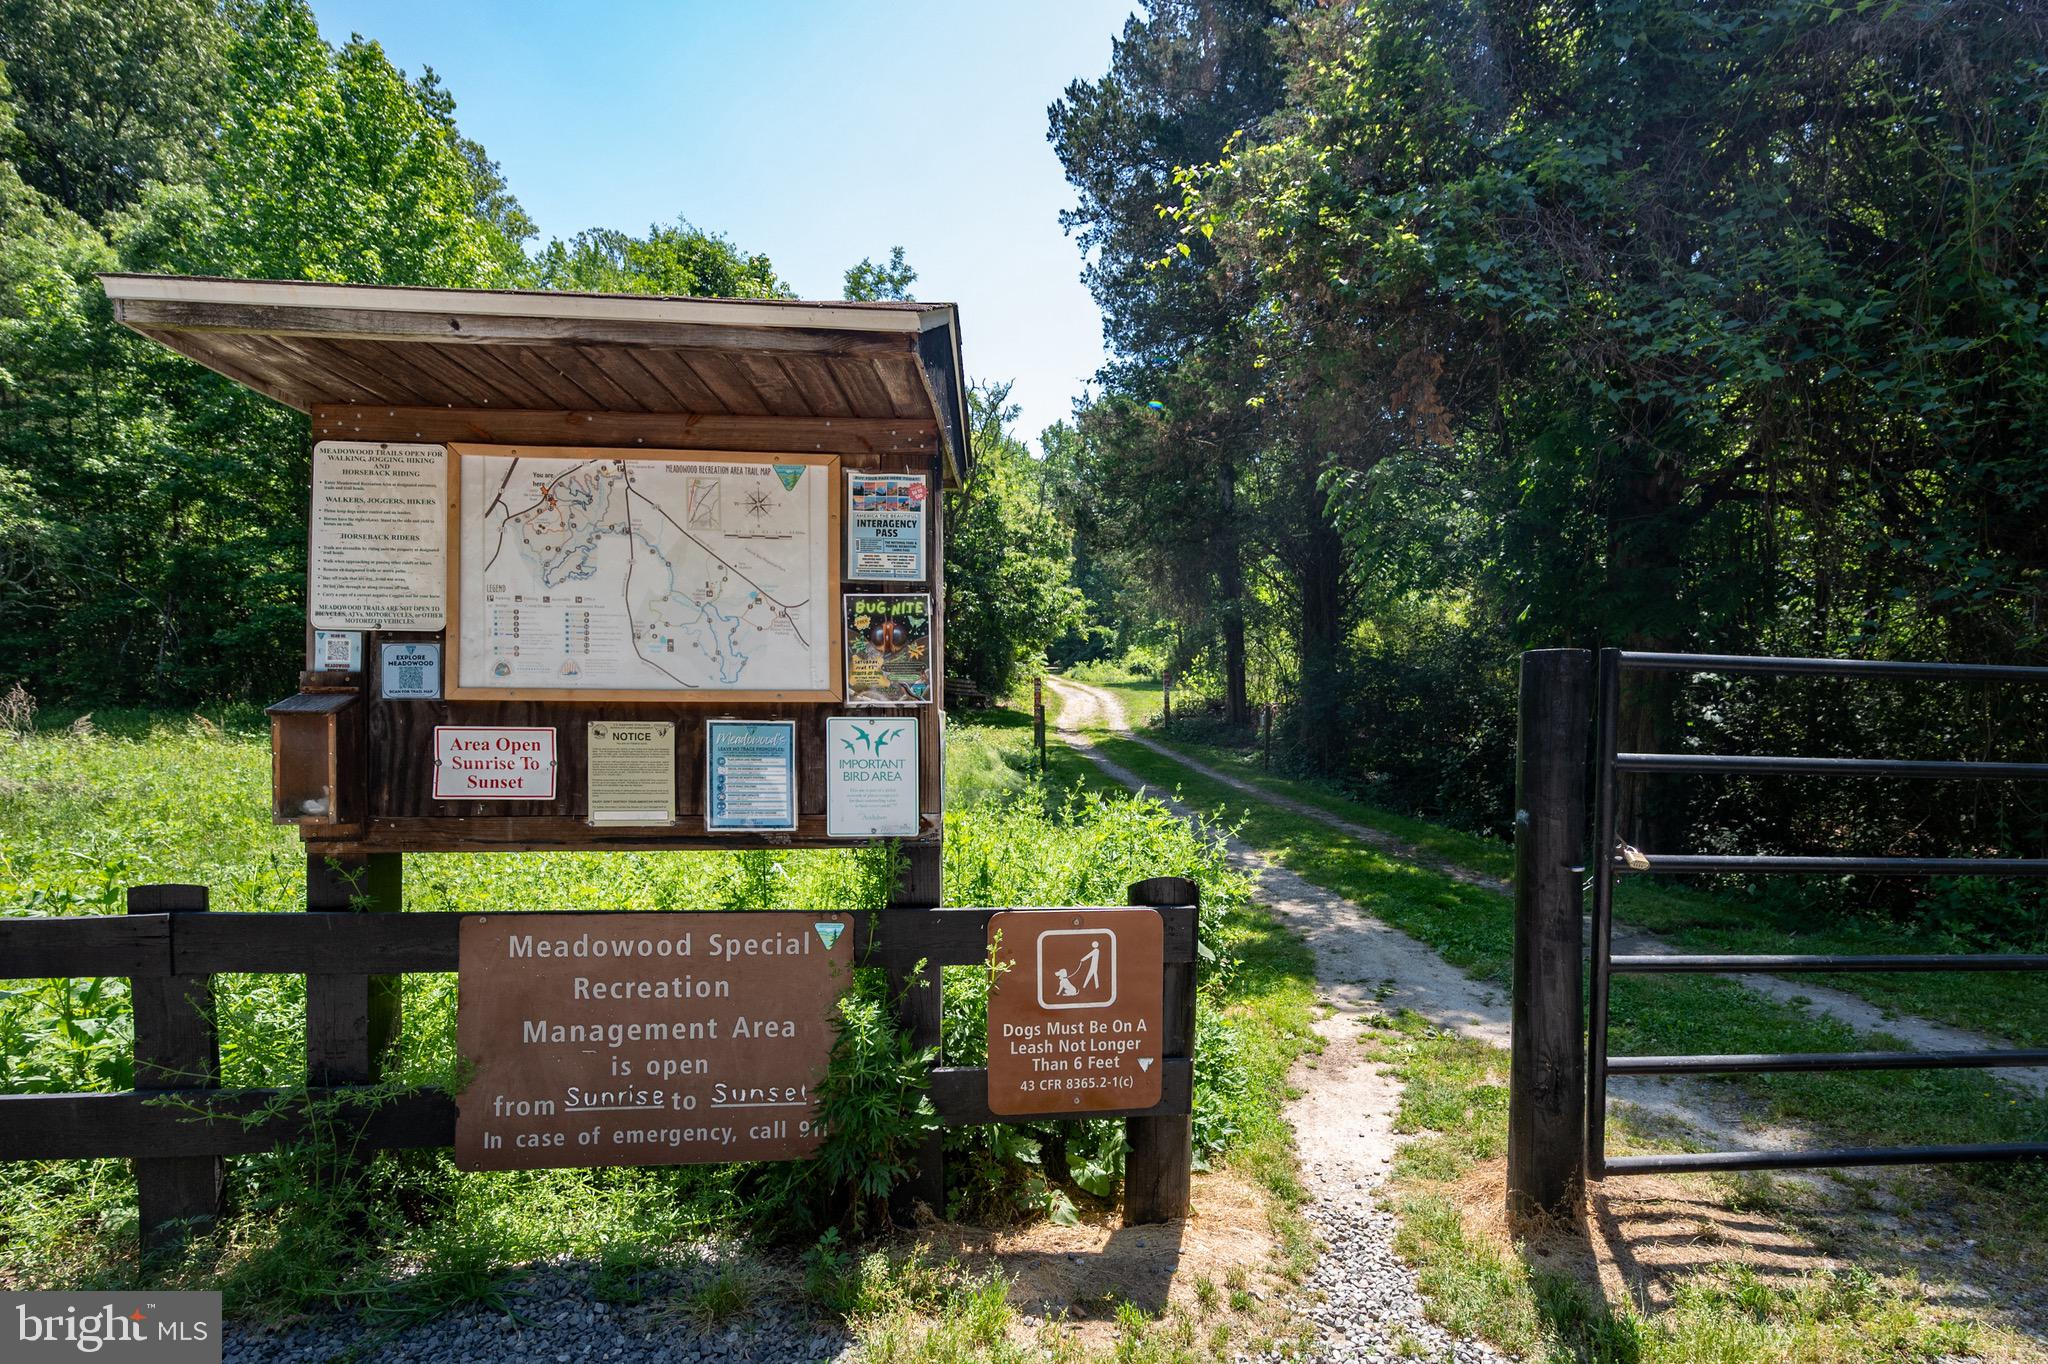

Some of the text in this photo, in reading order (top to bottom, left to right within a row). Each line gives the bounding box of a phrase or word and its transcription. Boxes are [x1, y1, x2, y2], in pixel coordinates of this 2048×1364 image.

[319, 447, 374, 455] MEADOWOOD
[666, 465, 770, 475] MEADOWOOD RECREATION AREA TRAIL MAP
[326, 496, 366, 504] WALKERS,
[857, 519, 918, 529] INTERAGENCY
[876, 529, 898, 538] PASS
[487, 584, 506, 593] LEGEND
[856, 601, 924, 616] BUG NITE
[612, 732, 652, 741] NOTICE
[716, 731, 786, 746] Meadowood's
[450, 738, 541, 755] Area Open
[452, 756, 540, 770] Sunrise To
[839, 759, 906, 769] IMPORTANT
[467, 775, 524, 789] Sunset
[843, 771, 902, 782] BIRD AREA
[509, 932, 810, 962] Meadowood Special
[574, 976, 730, 1000] Recreation
[523, 1016, 796, 1048] Management Area
[1003, 1018, 1147, 1039] Dogs Must Be On A
[1010, 1038, 1141, 1055] Leash Not Longer
[612, 1056, 708, 1081] is open
[1032, 1055, 1120, 1072] Than 6 Feet
[1020, 1075, 1134, 1092] 43 CFR 8365.2-1(c)
[494, 1095, 555, 1117] from
[565, 1085, 664, 1107] Sunrise
[672, 1092, 697, 1111] to
[484, 1132, 502, 1150] In
[516, 1132, 565, 1148] case
[578, 1126, 601, 1146] of
[613, 1124, 737, 1148] emergency,
[749, 1120, 786, 1141] call
